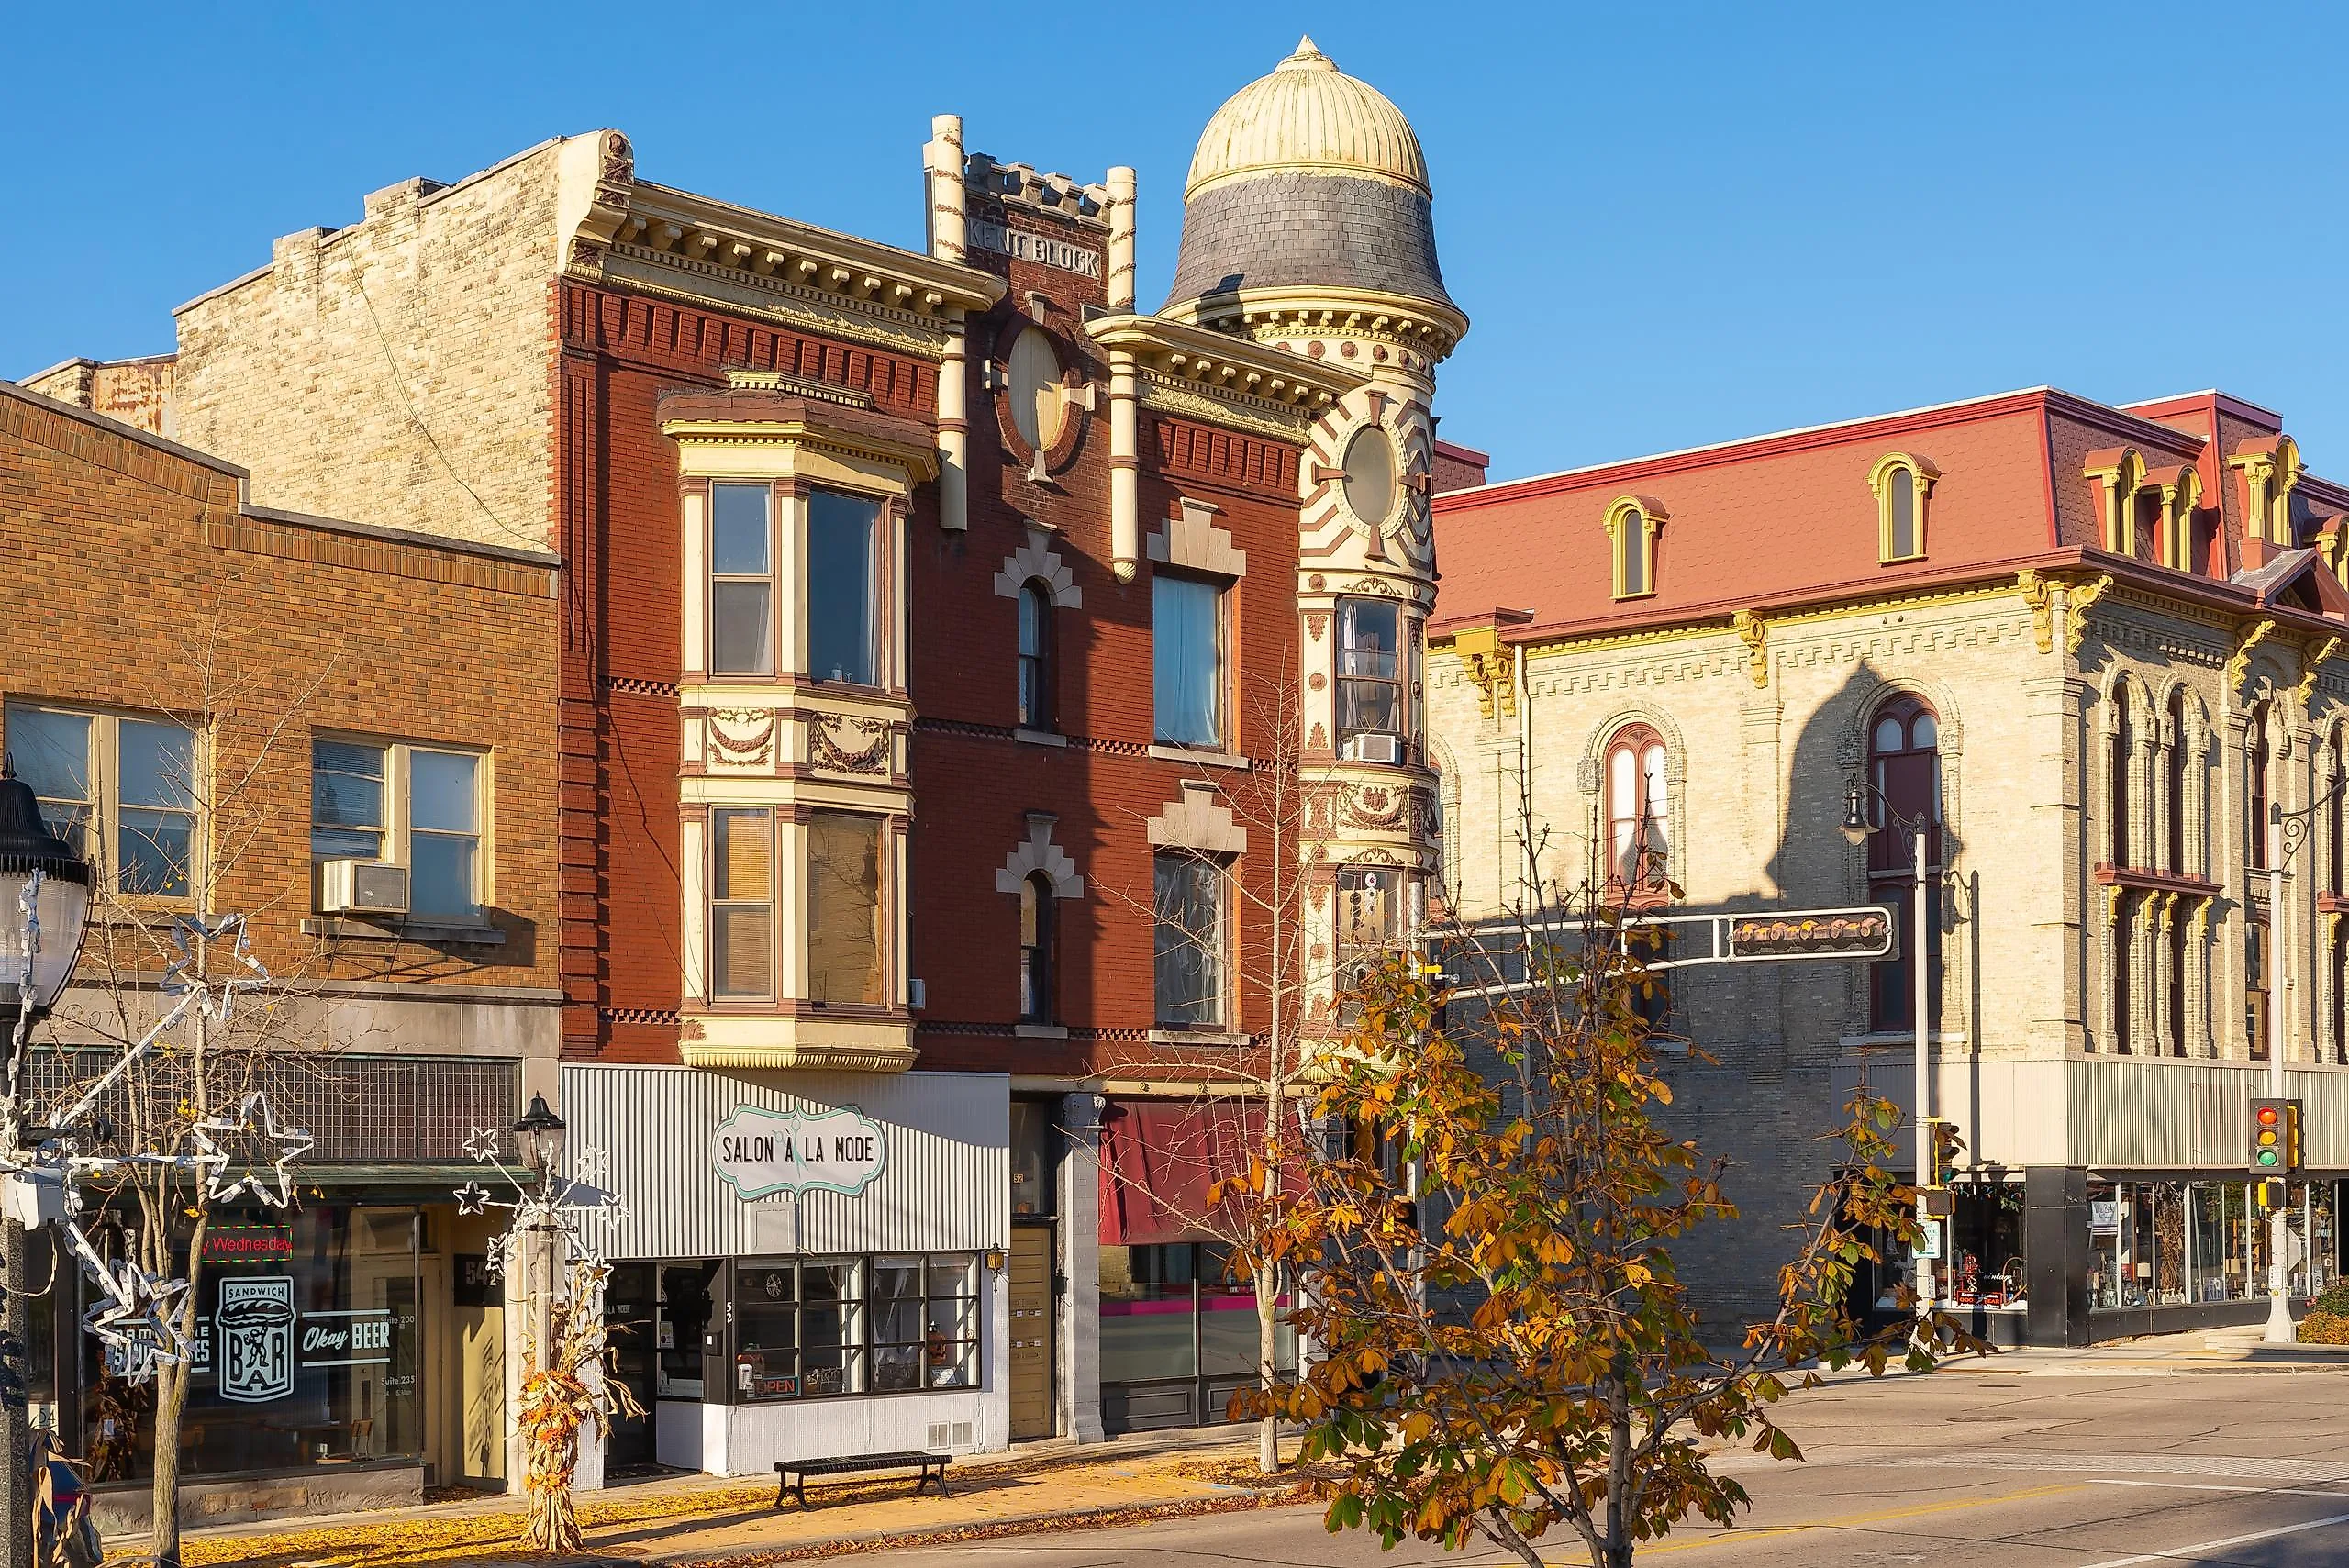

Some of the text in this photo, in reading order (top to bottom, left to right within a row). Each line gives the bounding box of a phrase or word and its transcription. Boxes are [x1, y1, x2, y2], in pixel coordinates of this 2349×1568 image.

[1032, 237, 1100, 277] BLOCK
[722, 1136, 774, 1162] SALON
[805, 1137, 824, 1162] LA
[835, 1137, 875, 1162] MODE
[212, 1236, 294, 1256] Wednesday
[228, 1286, 284, 1299] SANDWICH
[302, 1321, 390, 1351] Okay BEER
[228, 1331, 285, 1392] BAR
[381, 1376, 416, 1386] Suite 235
